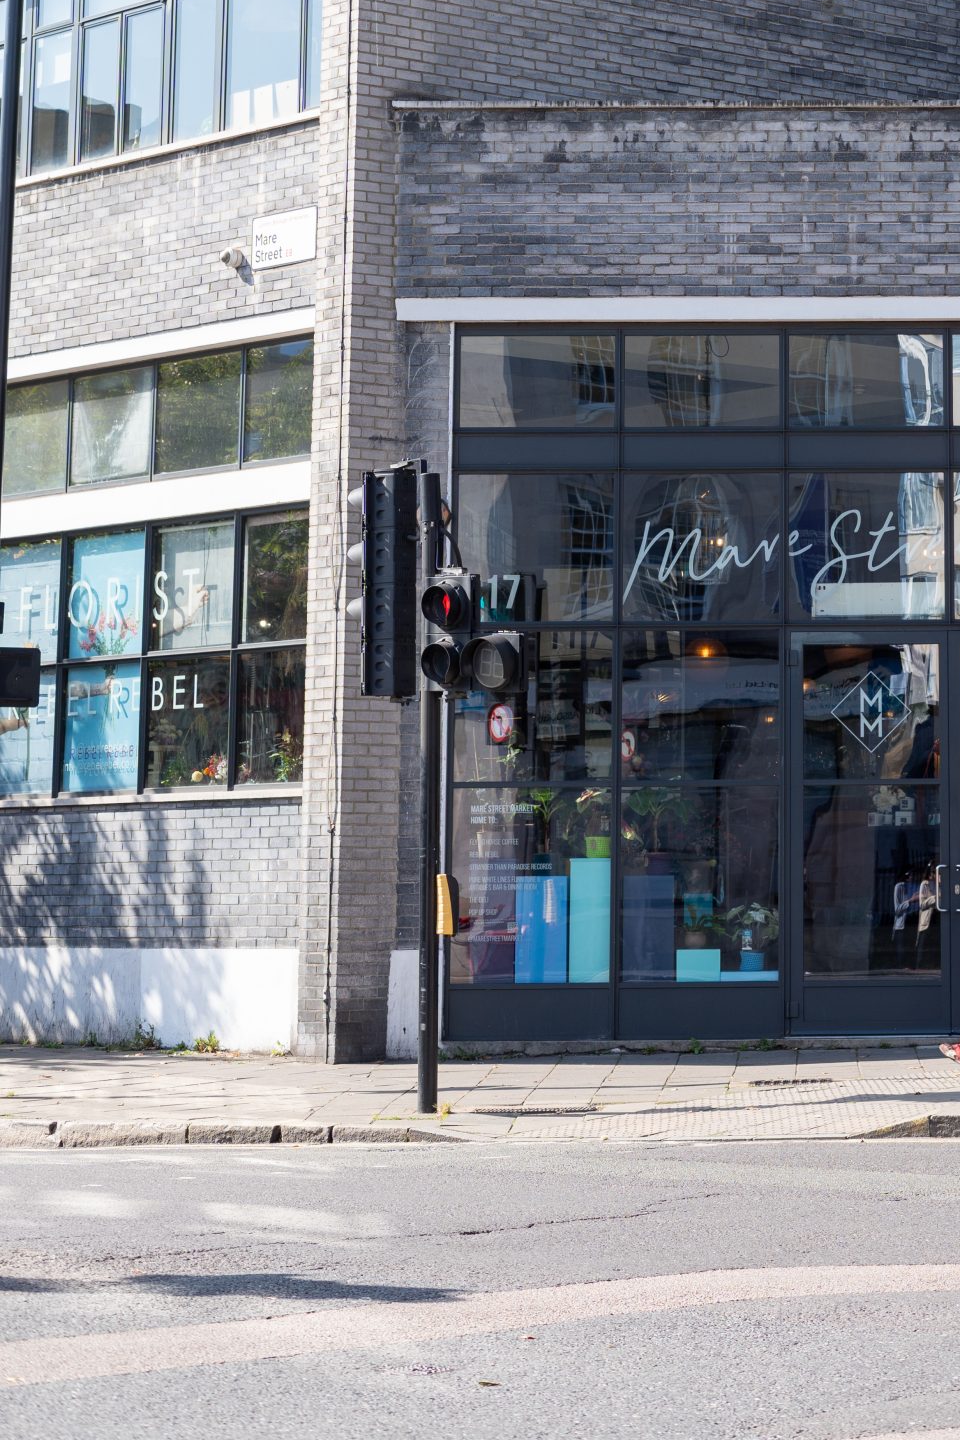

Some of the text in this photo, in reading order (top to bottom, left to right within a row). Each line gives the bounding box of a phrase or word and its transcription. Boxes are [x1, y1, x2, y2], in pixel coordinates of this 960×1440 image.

[255, 233, 277, 247] Mare
[255, 246, 282, 263] Street
[622, 520, 813, 606] Mare
[19, 568, 200, 633] FLORIST
[471, 804, 533, 812] MARE STREET MARKET
[471, 816, 487, 824] HOME
